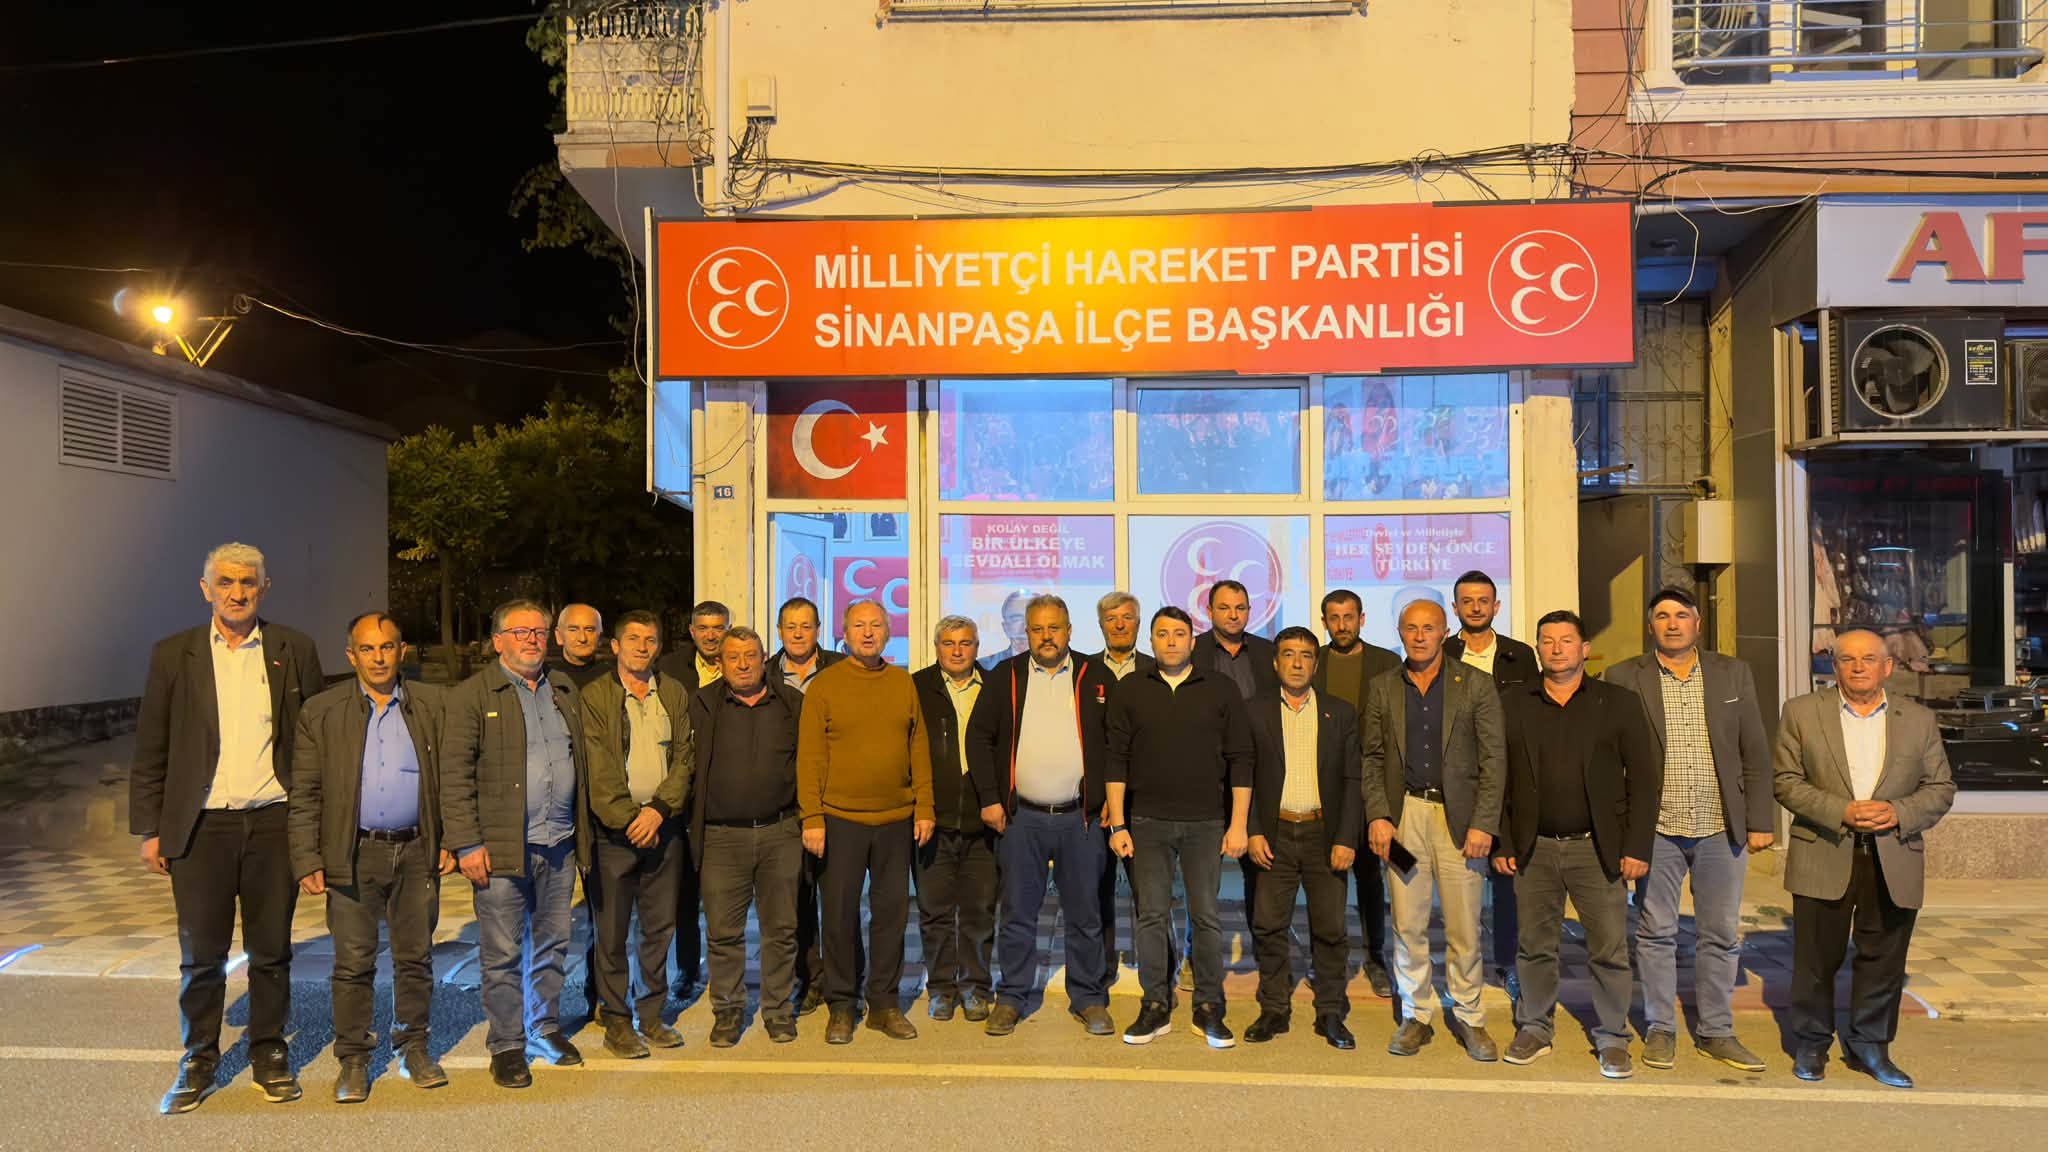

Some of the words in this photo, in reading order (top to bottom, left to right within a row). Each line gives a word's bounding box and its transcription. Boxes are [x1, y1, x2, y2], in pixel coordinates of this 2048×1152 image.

[815, 243, 1050, 295] MİLLİYETÇİ
[1066, 246, 1276, 285] HAREKET
[1291, 232, 1463, 280] PARTİSİ
[815, 305, 1063, 354] SİNANPAŞA
[1076, 301, 1172, 352] İLÇE
[1187, 292, 1464, 350] BAŞKANLIĞI
[715, 487, 732, 497] 16
[987, 524, 1029, 534] KOLAY
[1033, 521, 1071, 534] DEĞİL
[972, 535, 1003, 550] BİR
[1010, 533, 1086, 550] ÜLKEYE
[1336, 541, 1369, 555] HER
[1446, 538, 1495, 554] ÖNCE
[1037, 554, 1105, 568] OLMAK
